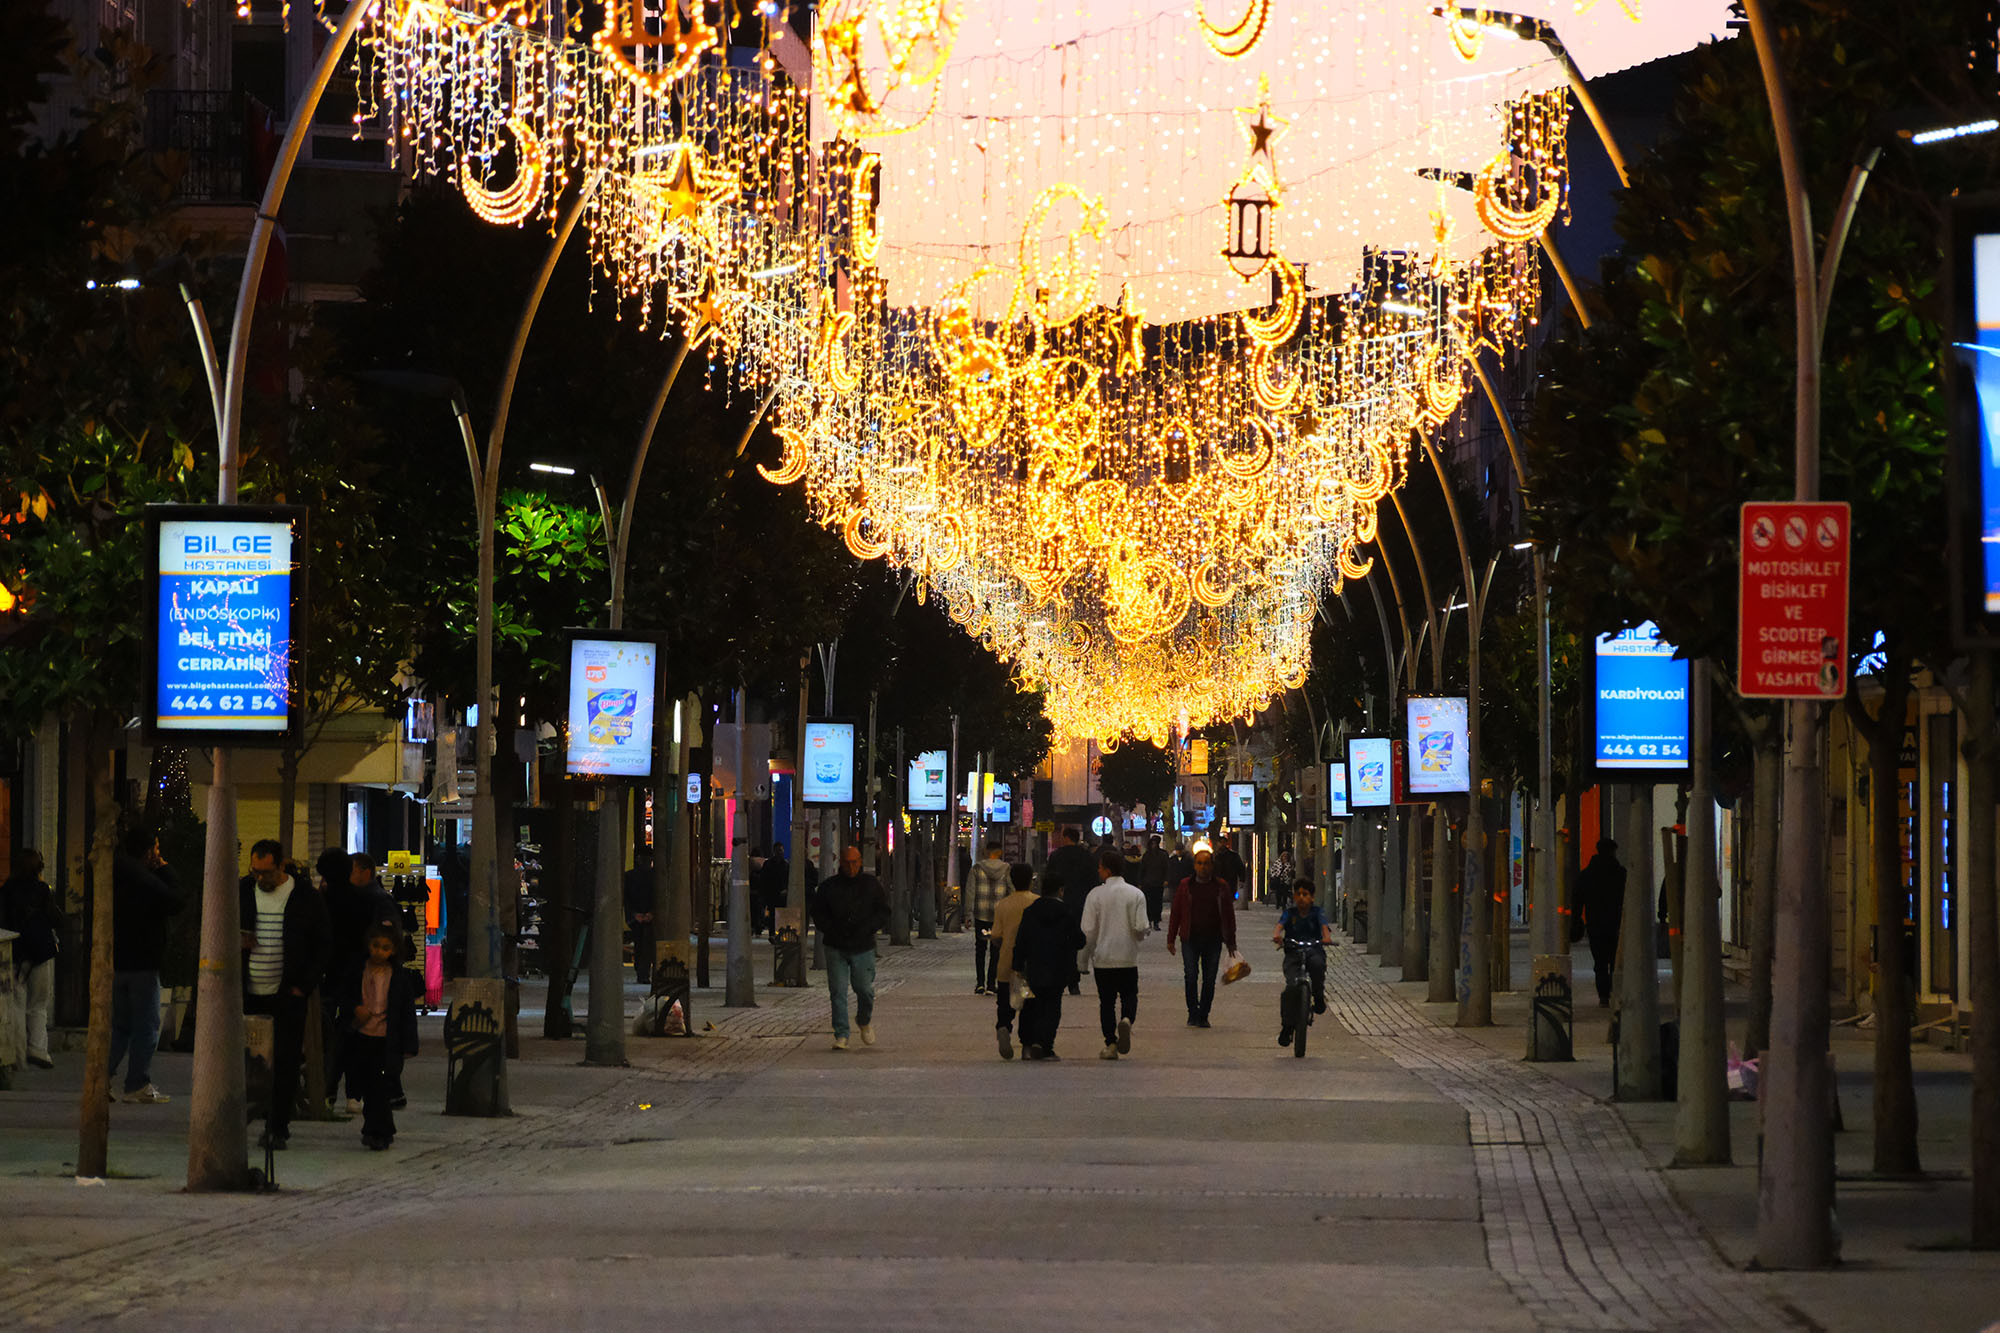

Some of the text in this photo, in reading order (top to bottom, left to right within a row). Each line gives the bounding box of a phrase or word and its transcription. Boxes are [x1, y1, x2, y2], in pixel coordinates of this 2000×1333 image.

[1746, 557, 1842, 577] MOTOSİKLET
[191, 580, 259, 595] KAPALI
[1759, 580, 1829, 599] BİSİKLET
[169, 605, 281, 622] (ENDOSKOPİK)
[1783, 604, 1804, 621] VE
[178, 628, 271, 646] BEL FITIĞI
[1613, 644, 1674, 653] HASTANES
[178, 654, 271, 671] CERRAHİSİ
[1600, 685, 1685, 700] KARDİYOLOJİ
[171, 695, 278, 711] 444 62 54
[1603, 743, 1682, 756] 444 62 54
[393, 861, 406, 870] 50
